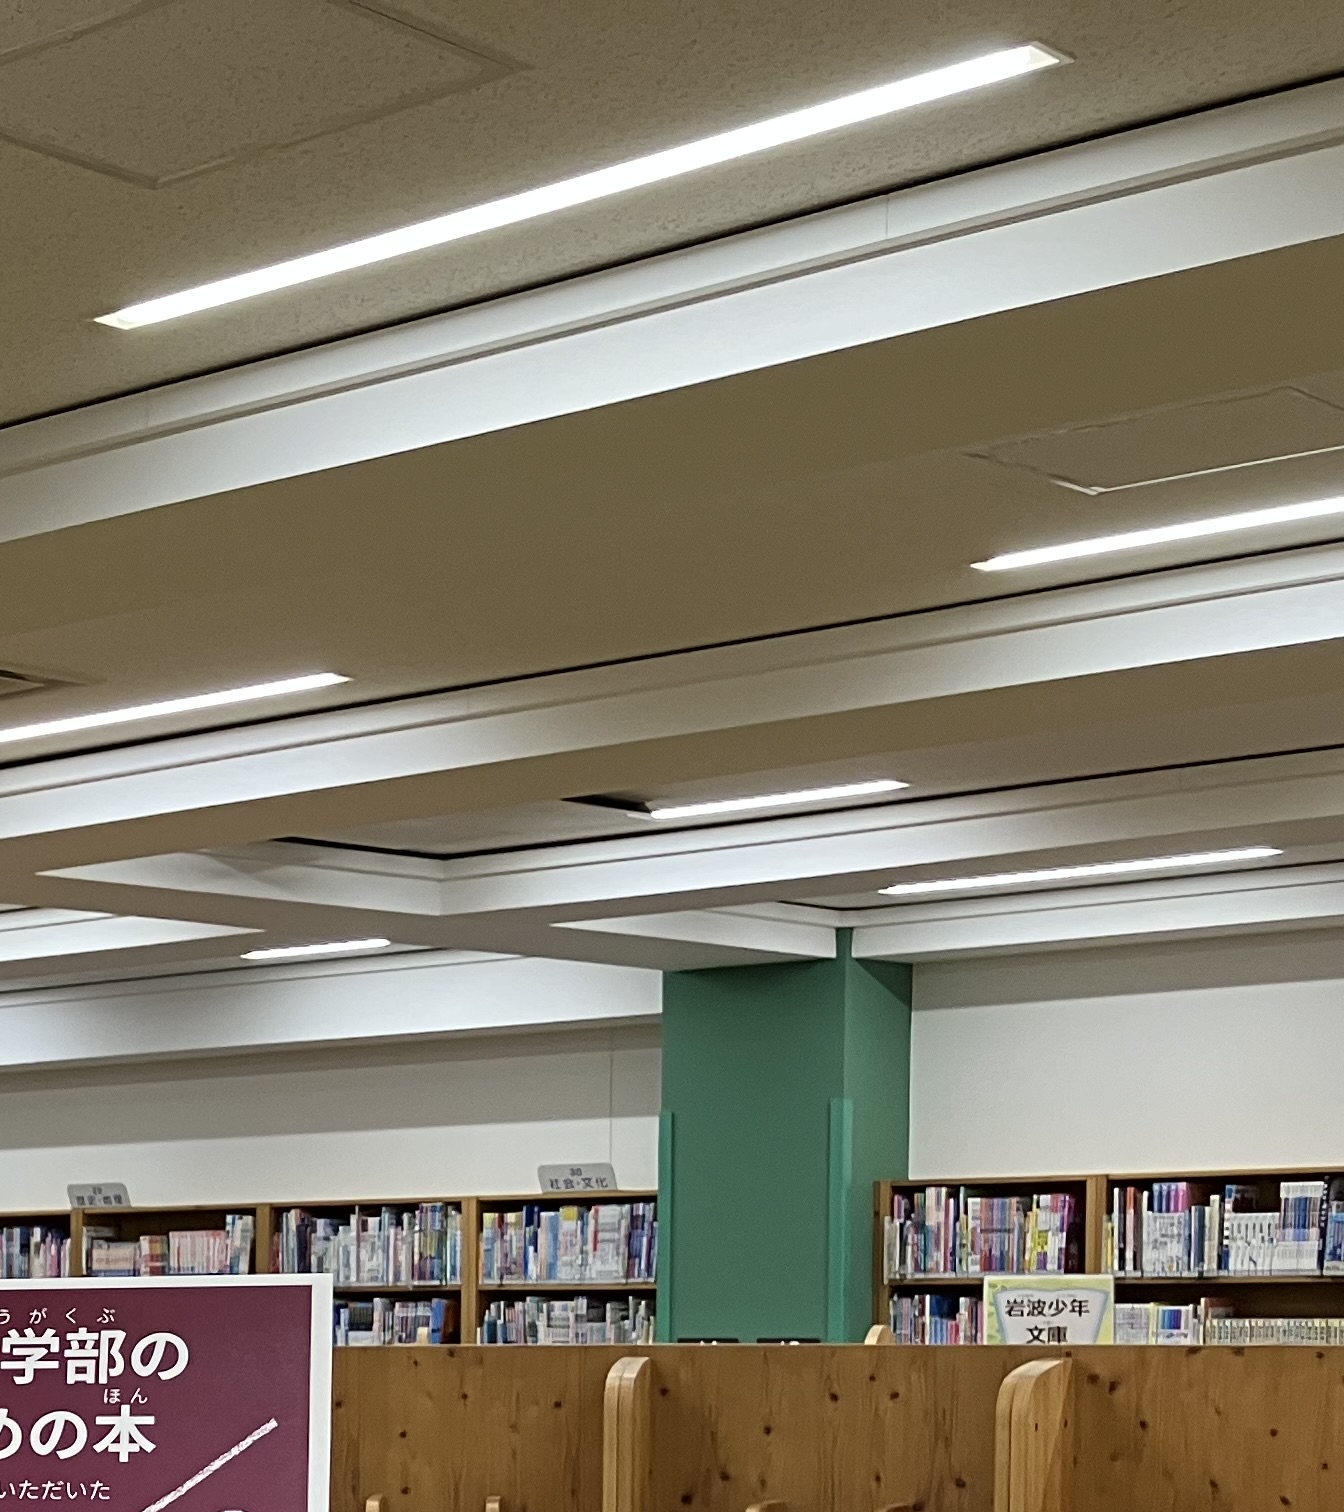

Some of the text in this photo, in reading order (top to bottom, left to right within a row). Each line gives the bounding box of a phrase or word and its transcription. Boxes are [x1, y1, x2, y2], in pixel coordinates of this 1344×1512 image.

[1004, 1297, 1090, 1318] 岩波少年
[102, 1387, 148, 1405] ほん
